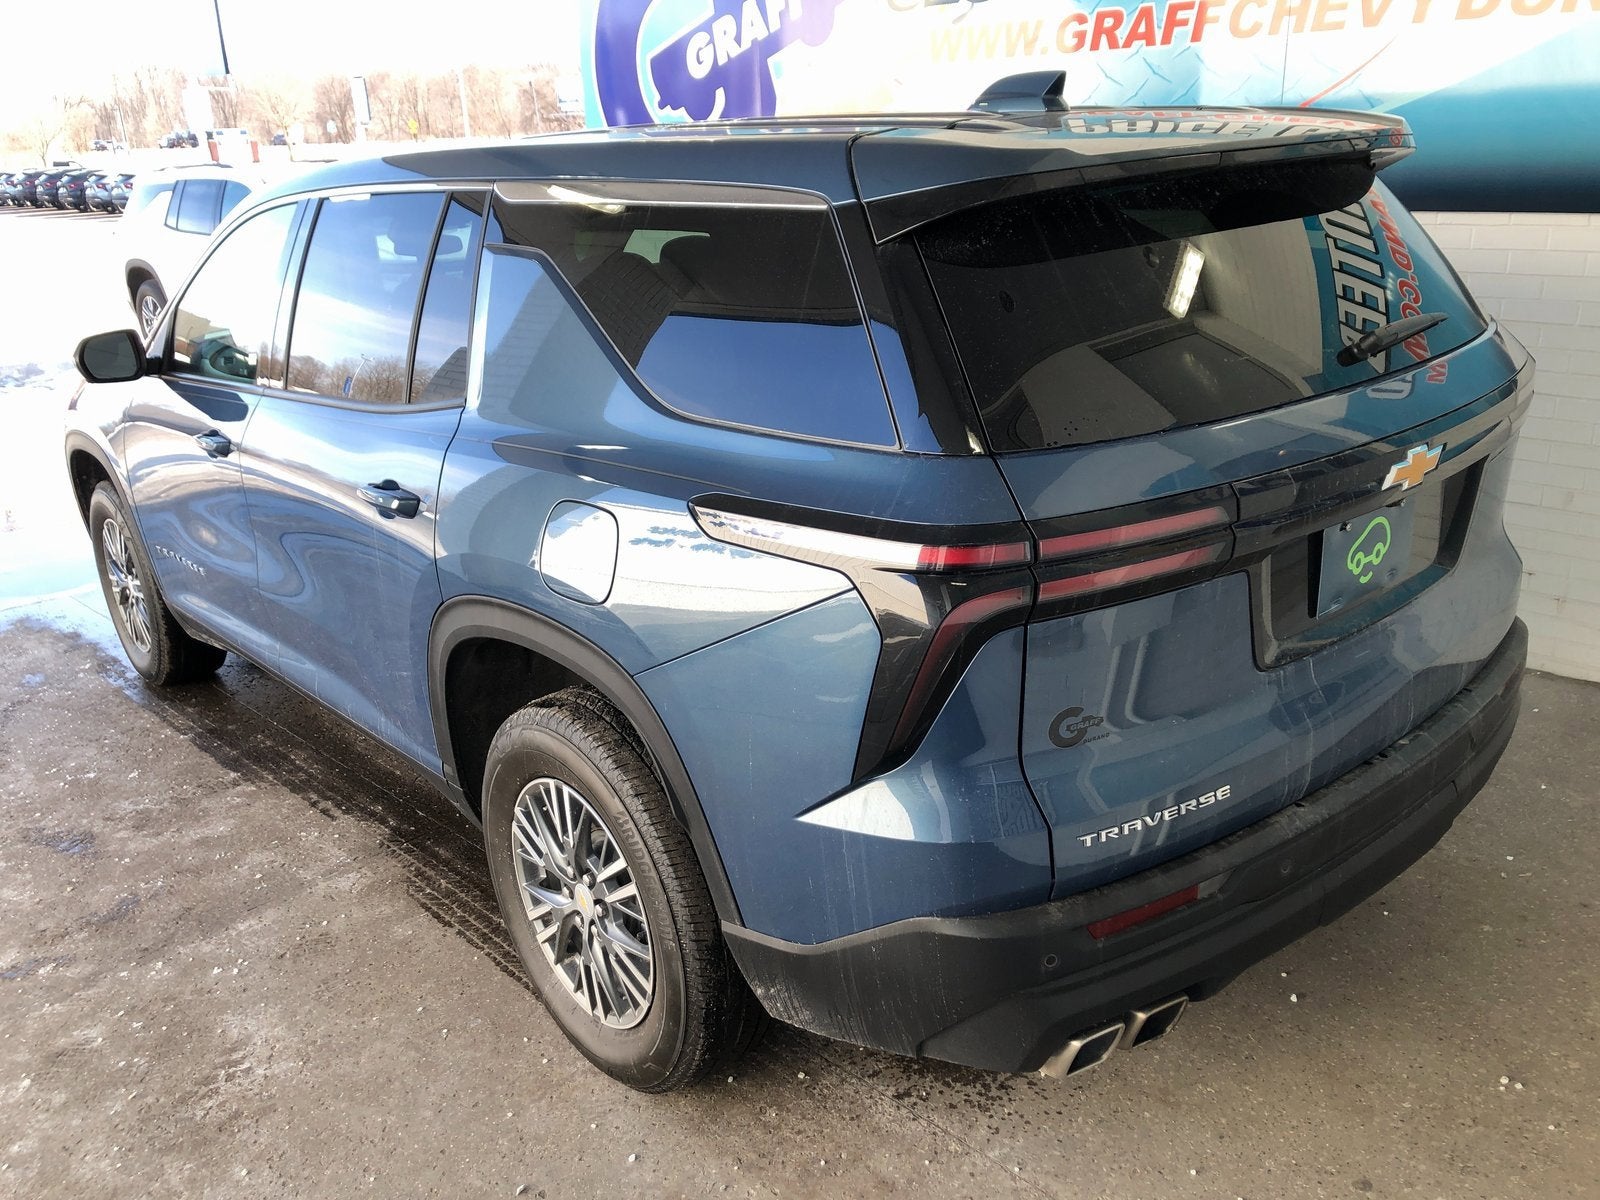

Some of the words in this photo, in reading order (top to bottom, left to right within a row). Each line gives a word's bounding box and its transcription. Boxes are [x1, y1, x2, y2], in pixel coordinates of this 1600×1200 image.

[154, 545, 207, 576] TRAVERSE
[1082, 732, 1110, 744] DURAND
[1077, 784, 1231, 848] TRAVERSE
